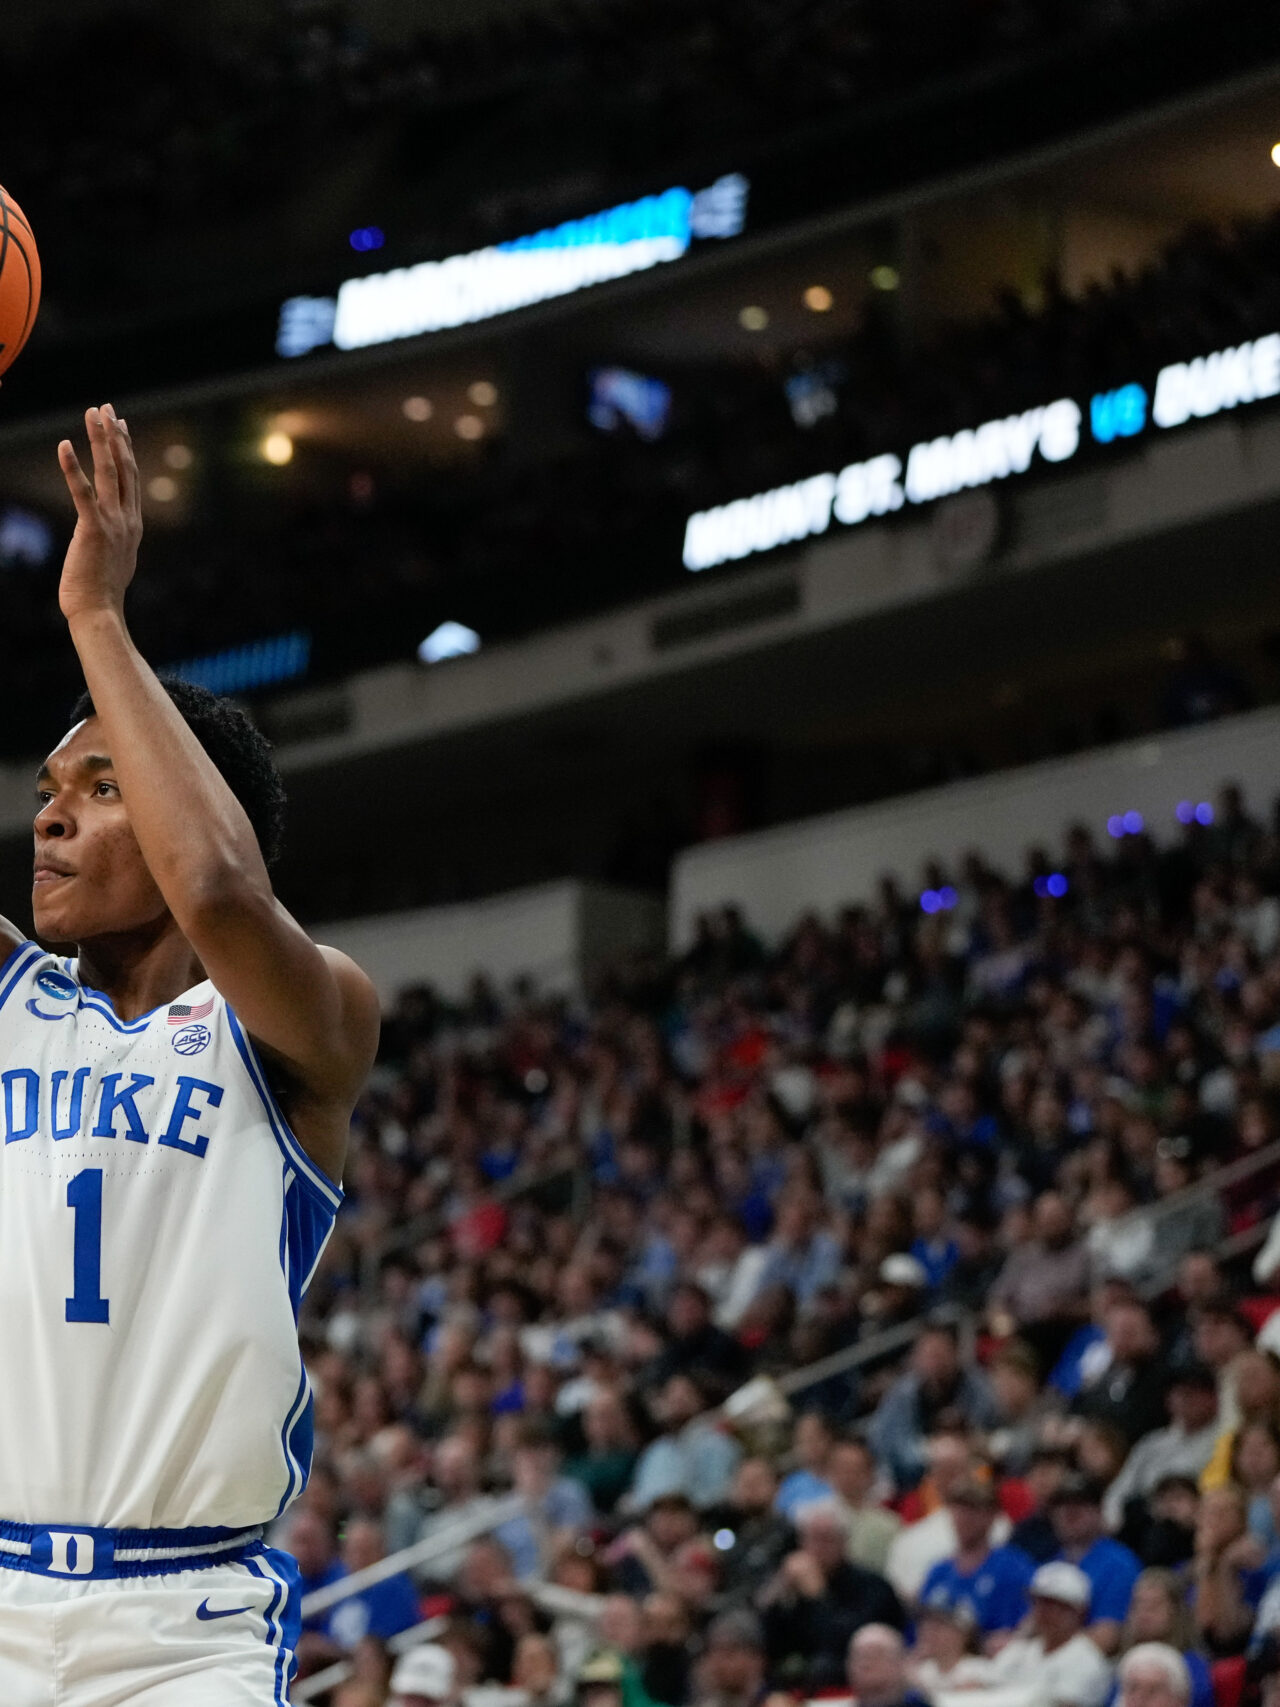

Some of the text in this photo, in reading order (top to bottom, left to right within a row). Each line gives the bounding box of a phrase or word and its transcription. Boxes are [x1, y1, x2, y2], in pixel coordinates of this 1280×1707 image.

[0, 1066, 225, 1159] DUKE
[65, 1168, 110, 1324] 1
[47, 1531, 95, 1575] D
